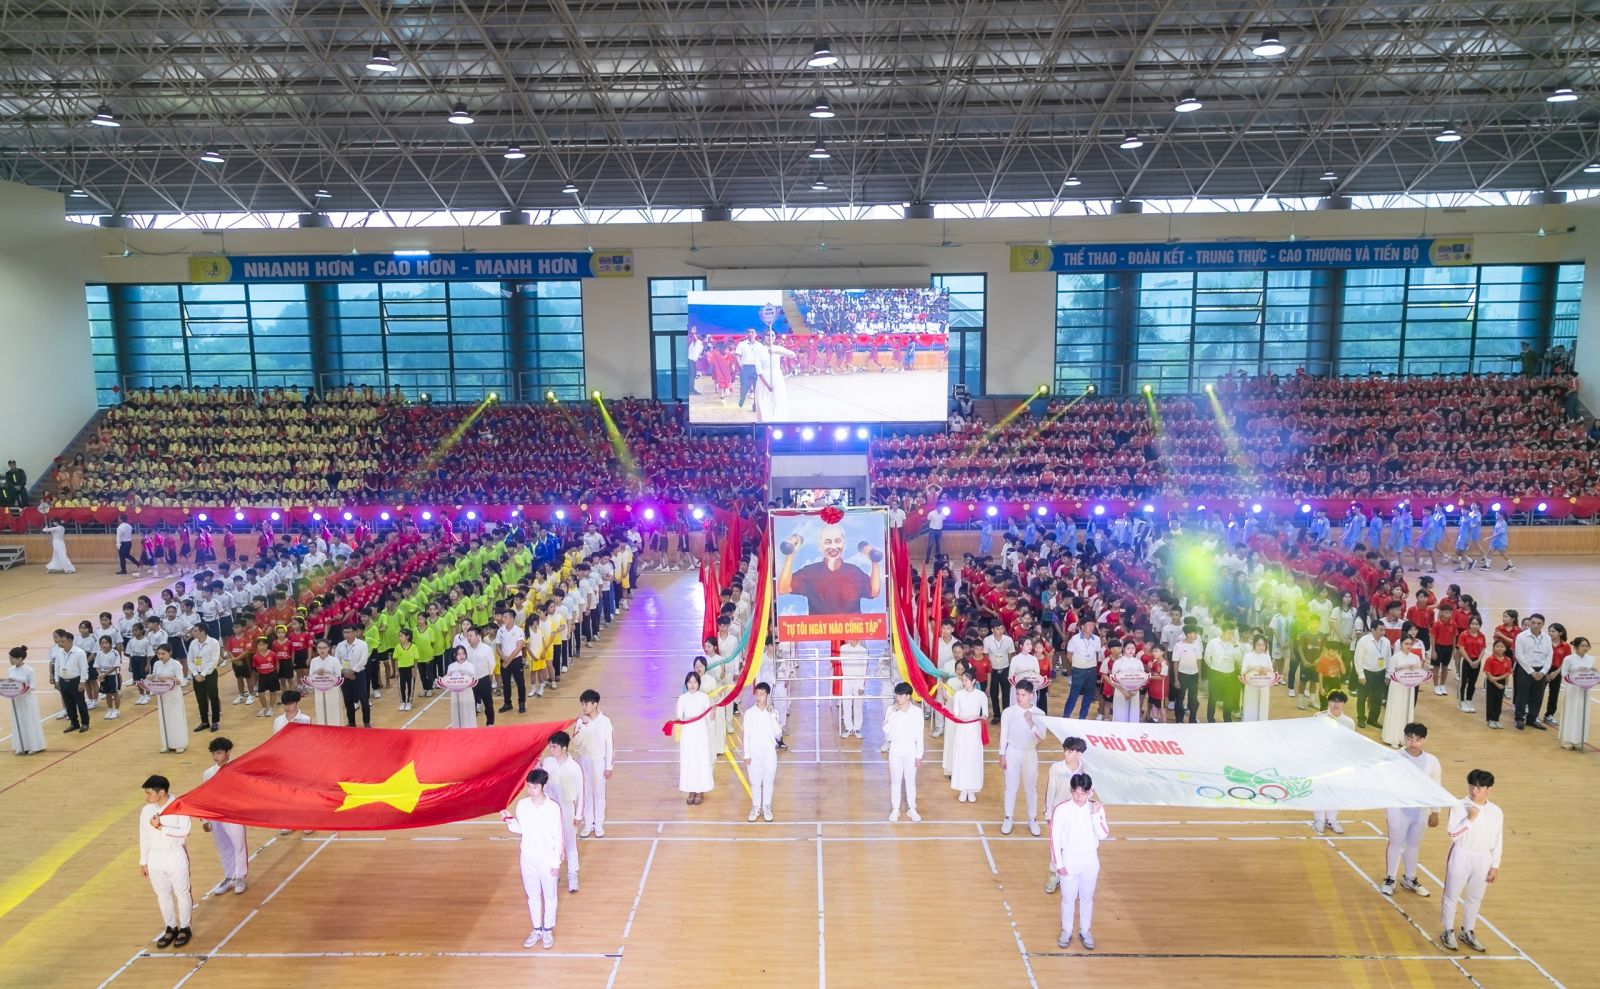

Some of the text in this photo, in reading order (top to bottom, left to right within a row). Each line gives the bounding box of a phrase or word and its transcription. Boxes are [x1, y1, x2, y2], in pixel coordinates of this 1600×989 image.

[1063, 246, 1084, 266] THỂ
[1088, 251, 1117, 266] THAO
[1128, 248, 1160, 265] ĐOÀN
[1163, 246, 1184, 265] KẾT
[1196, 249, 1234, 264] TRUNG
[1237, 248, 1267, 266] THỰC
[1279, 249, 1302, 263] CAO
[1306, 247, 1352, 264] THƯỢNG
[1355, 245, 1370, 262] VÀ
[1374, 243, 1400, 261] TIẾN
[1403, 244, 1419, 264] BỘ
[244, 261, 310, 277] NHANH
[315, 260, 354, 277] HƠN
[373, 260, 411, 276] CAO
[416, 259, 456, 276] HƠN
[475, 259, 532, 277] MẠNH
[538, 258, 577, 274] HƠN
[796, 621, 807, 635] TÔI
[809, 620, 828, 635] NGÀY
[829, 619, 843, 634] NÀO
[844, 620, 864, 634] CŨNG
[1086, 733, 1185, 755] PHÙ ĐỔNG
